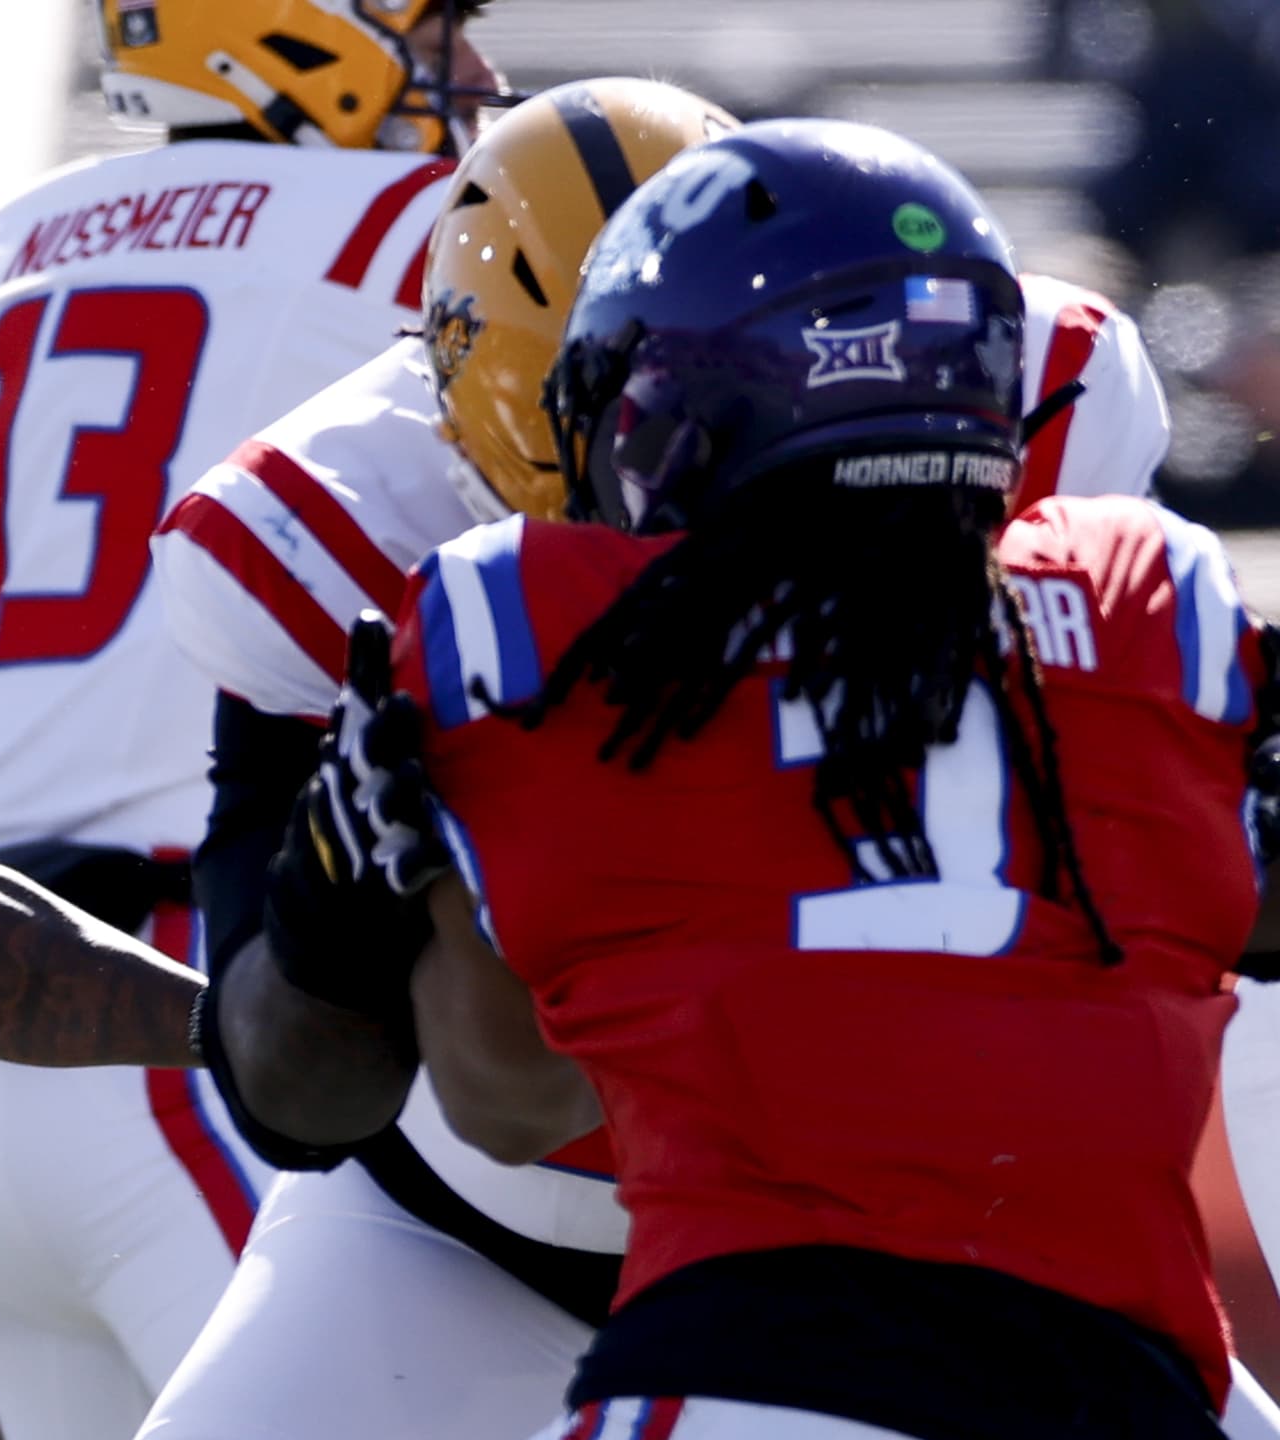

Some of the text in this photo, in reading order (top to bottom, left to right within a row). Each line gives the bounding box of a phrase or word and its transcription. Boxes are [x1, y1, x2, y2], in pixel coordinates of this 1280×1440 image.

[2, 181, 271, 284] NUSSMEIER
[832, 452, 1013, 491] HORNED FROGS
